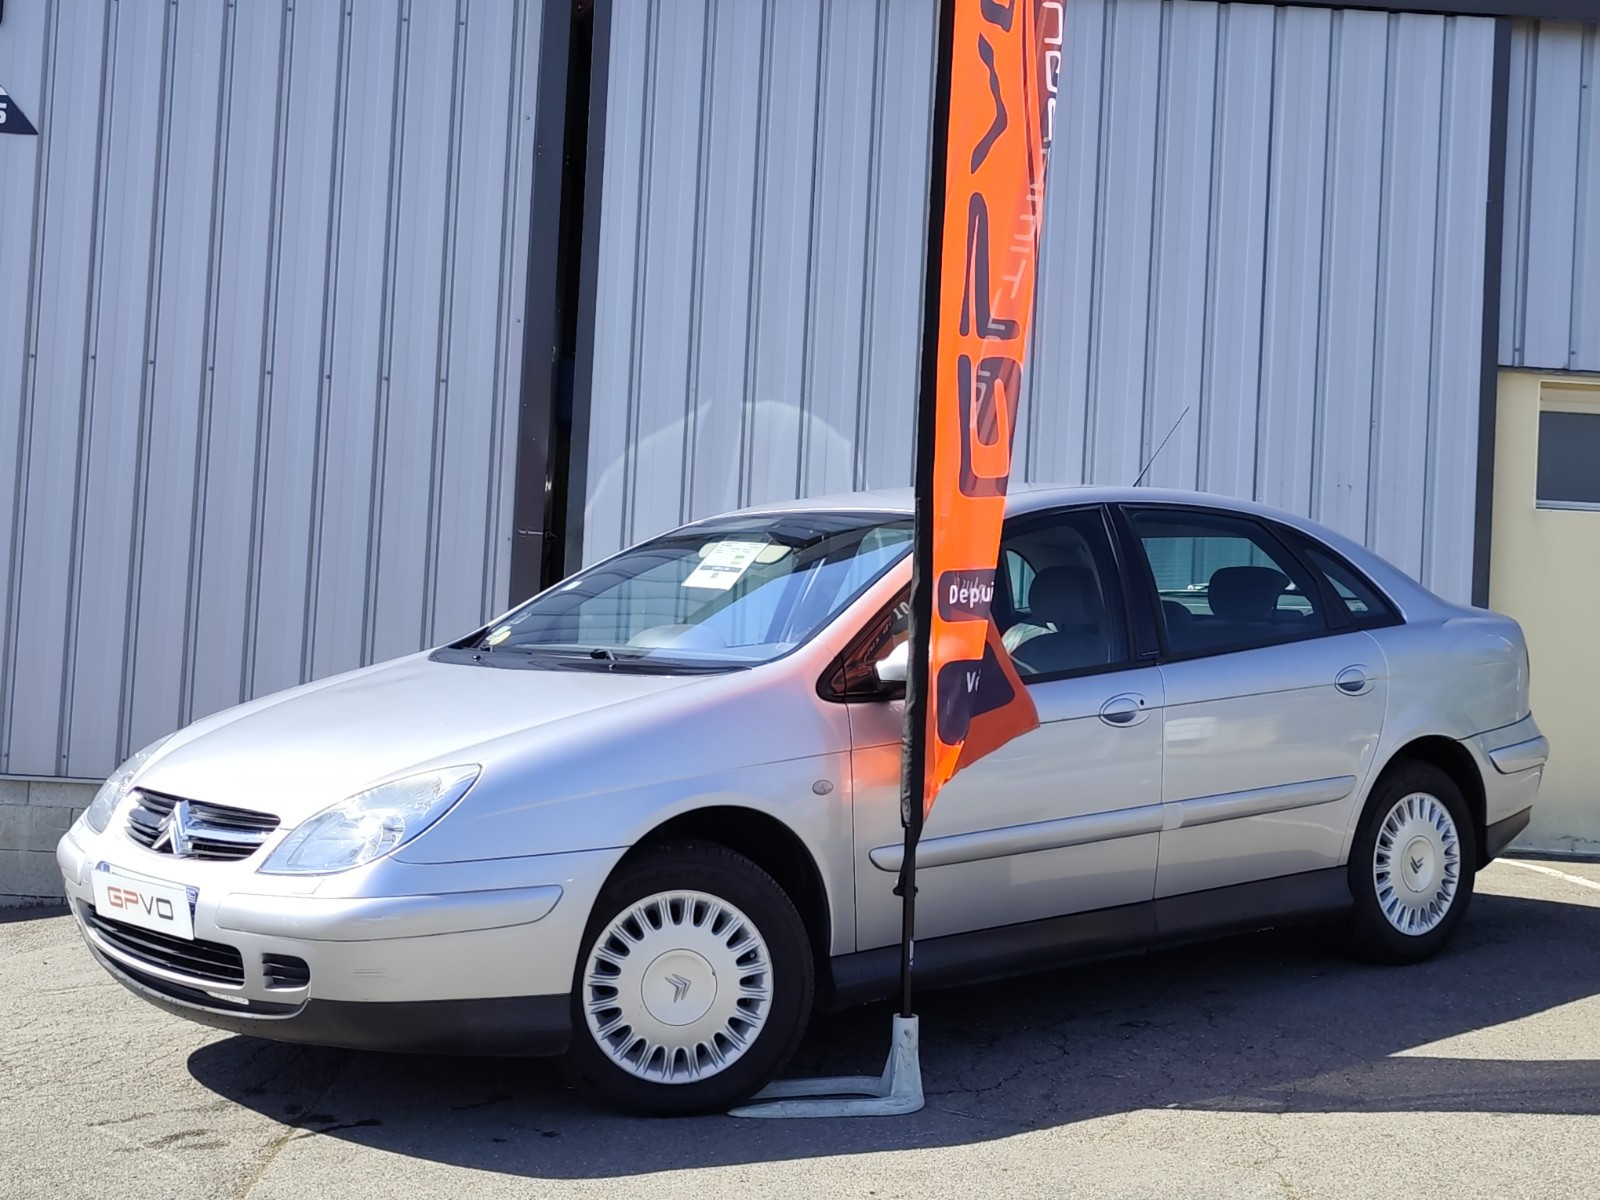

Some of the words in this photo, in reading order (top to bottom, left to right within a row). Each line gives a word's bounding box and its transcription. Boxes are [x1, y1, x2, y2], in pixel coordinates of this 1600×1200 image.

[958, 0, 1022, 498] GPV
[949, 580, 994, 609] Depui
[966, 668, 983, 693] Vi
[107, 886, 174, 920] GPVO
